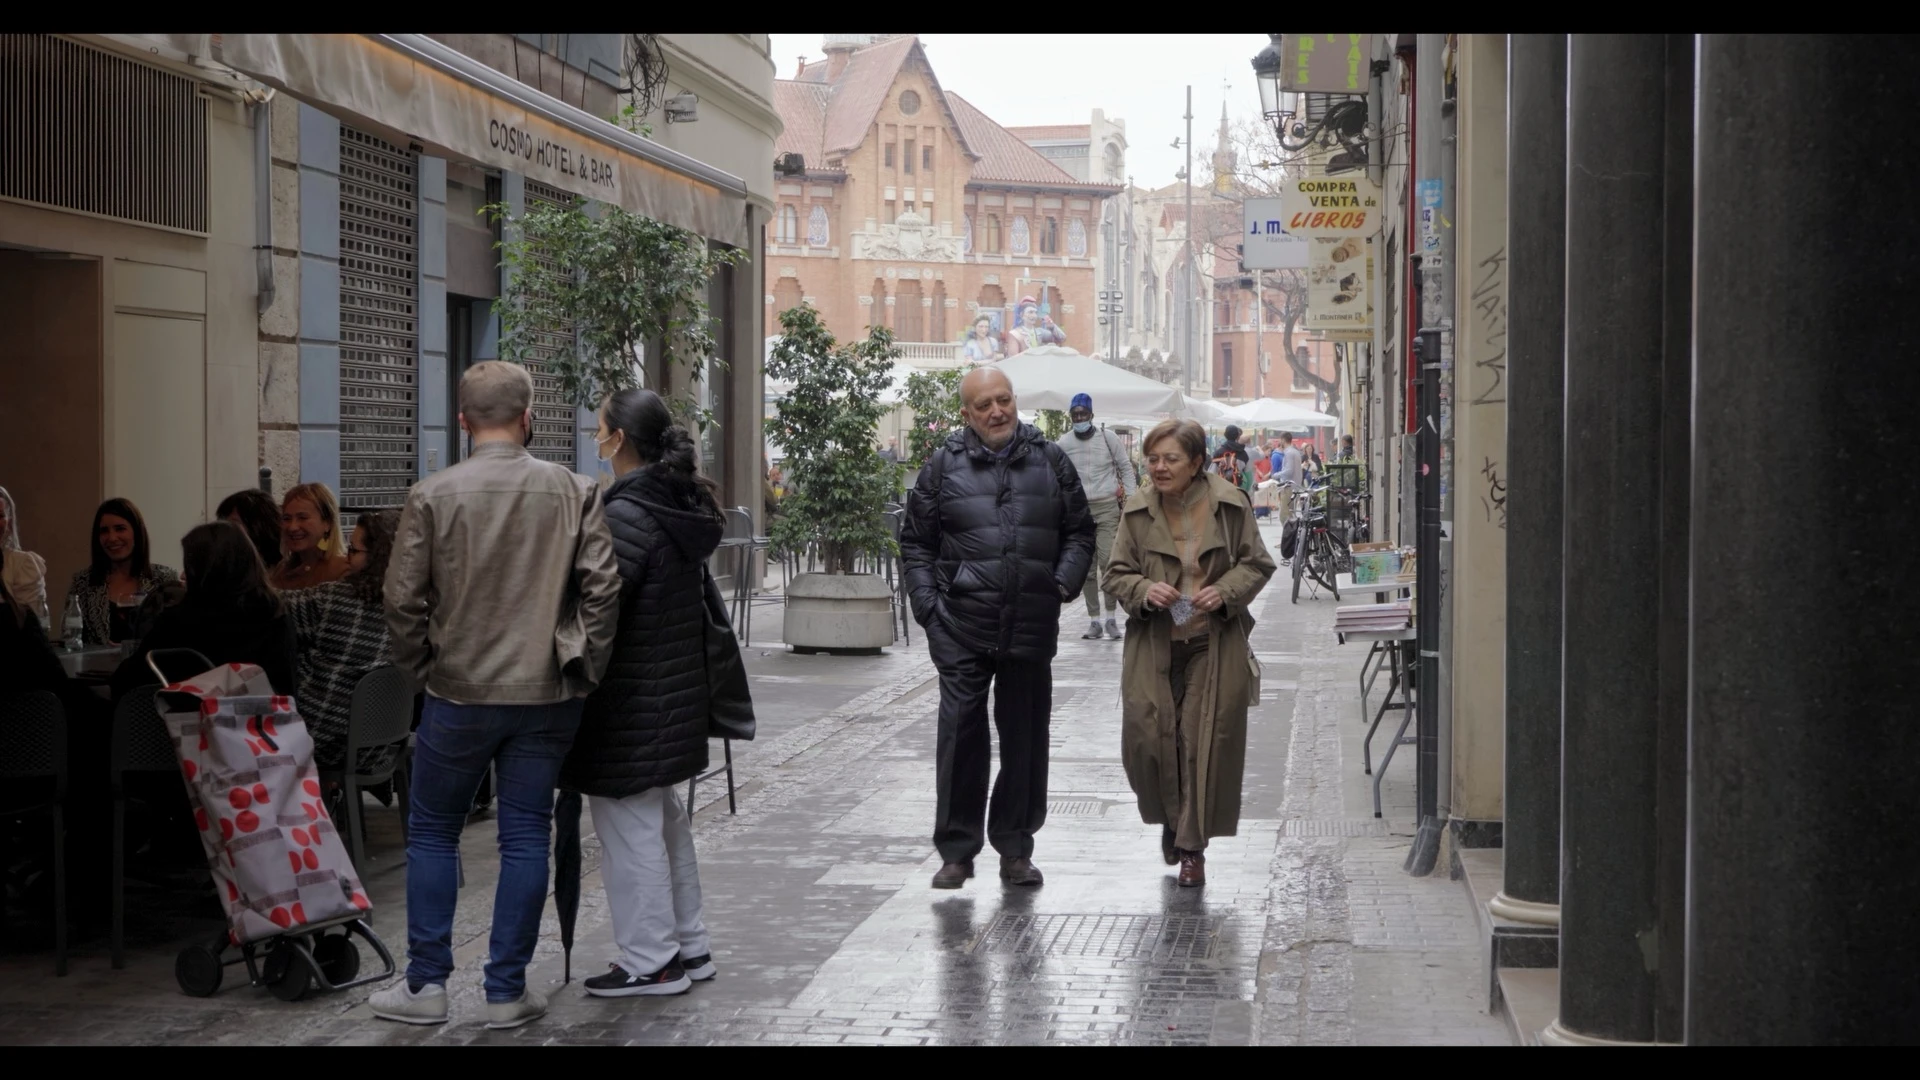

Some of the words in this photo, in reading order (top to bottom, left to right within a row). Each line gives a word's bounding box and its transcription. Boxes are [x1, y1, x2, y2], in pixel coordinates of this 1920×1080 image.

[489, 119, 532, 160] COSMO
[536, 138, 575, 176] HOTEL
[579, 154, 588, 179] &
[590, 158, 615, 189] BAR
[1298, 182, 1357, 193] COMPRA
[1310, 196, 1360, 207] VENTA
[1364, 196, 1377, 207] de
[1290, 211, 1367, 229] LIBROS
[1250, 221, 1261, 235] J.
